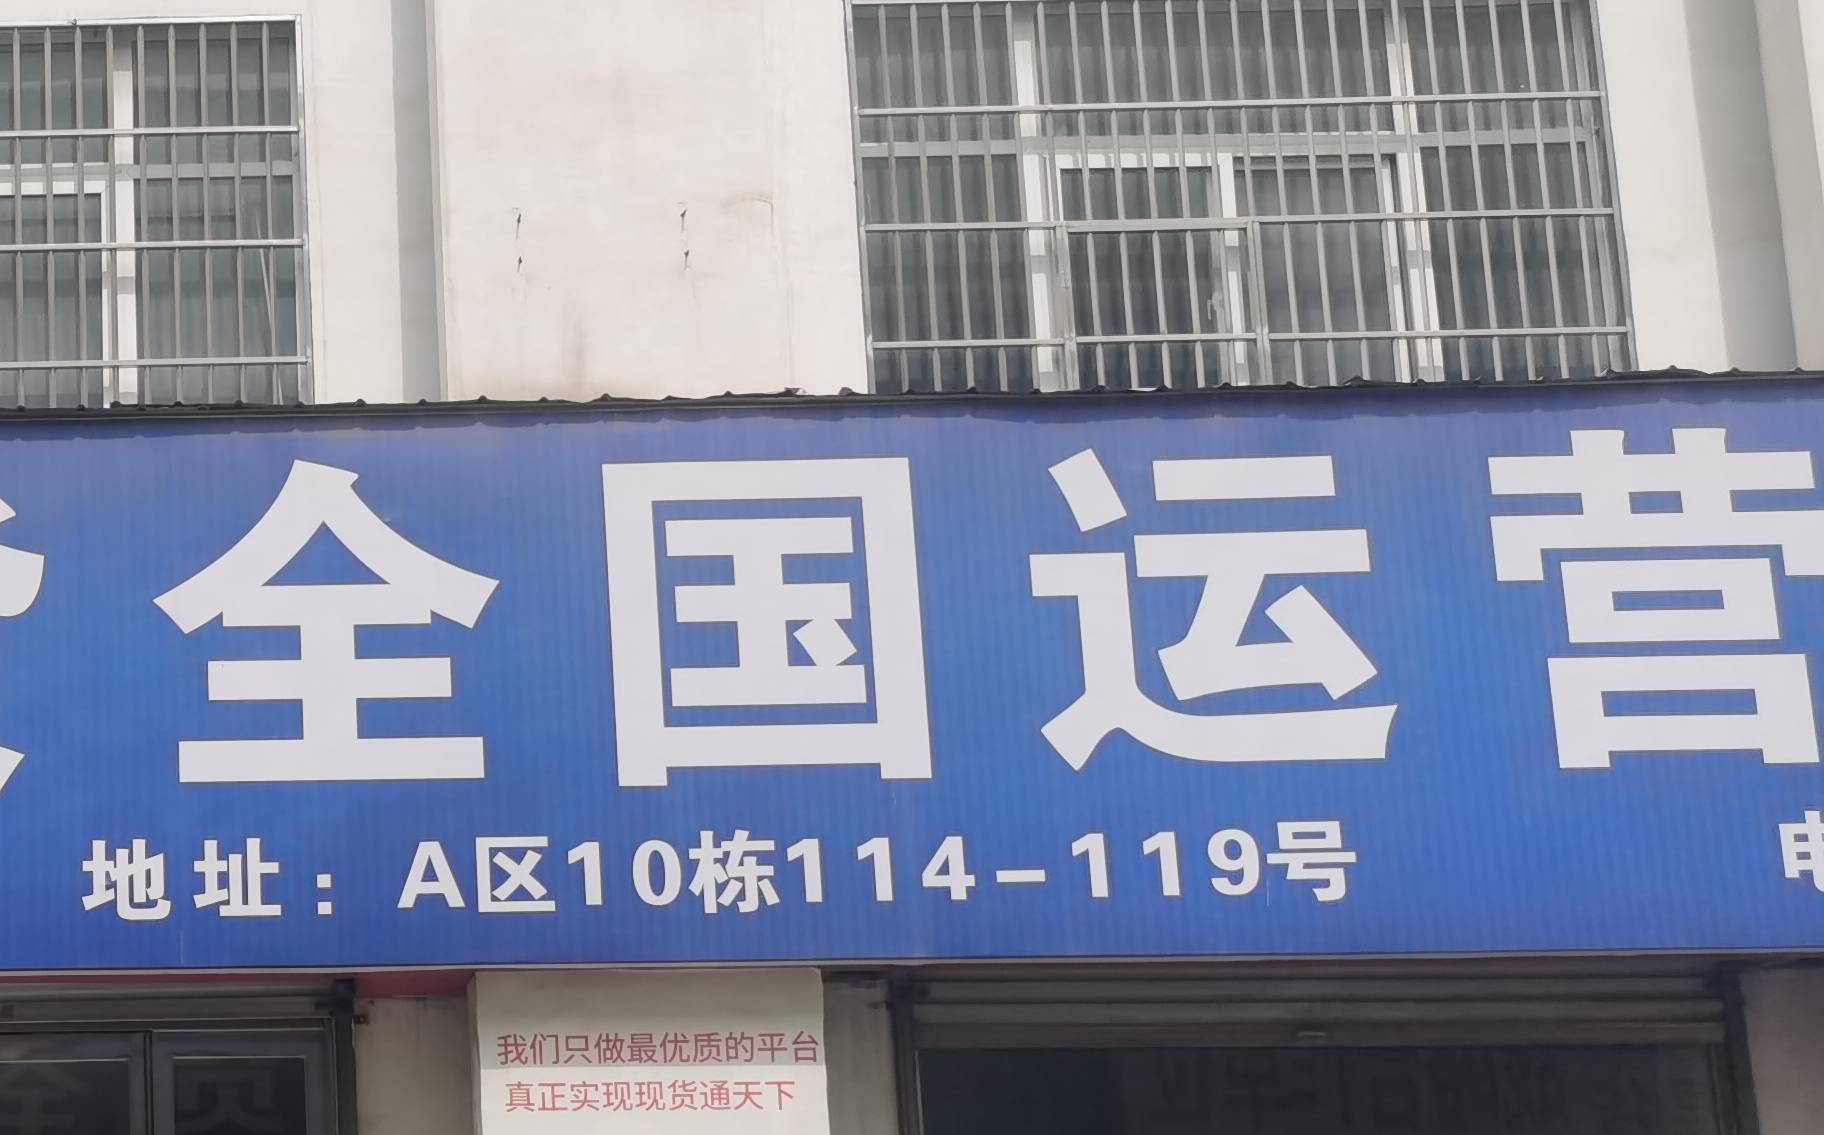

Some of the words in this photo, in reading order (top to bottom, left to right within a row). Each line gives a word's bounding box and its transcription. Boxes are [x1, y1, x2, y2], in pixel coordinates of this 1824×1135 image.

[496, 1031, 820, 1066] 我们只做最优质的平台
[504, 1079, 796, 1113] 真正实现现货通天下
